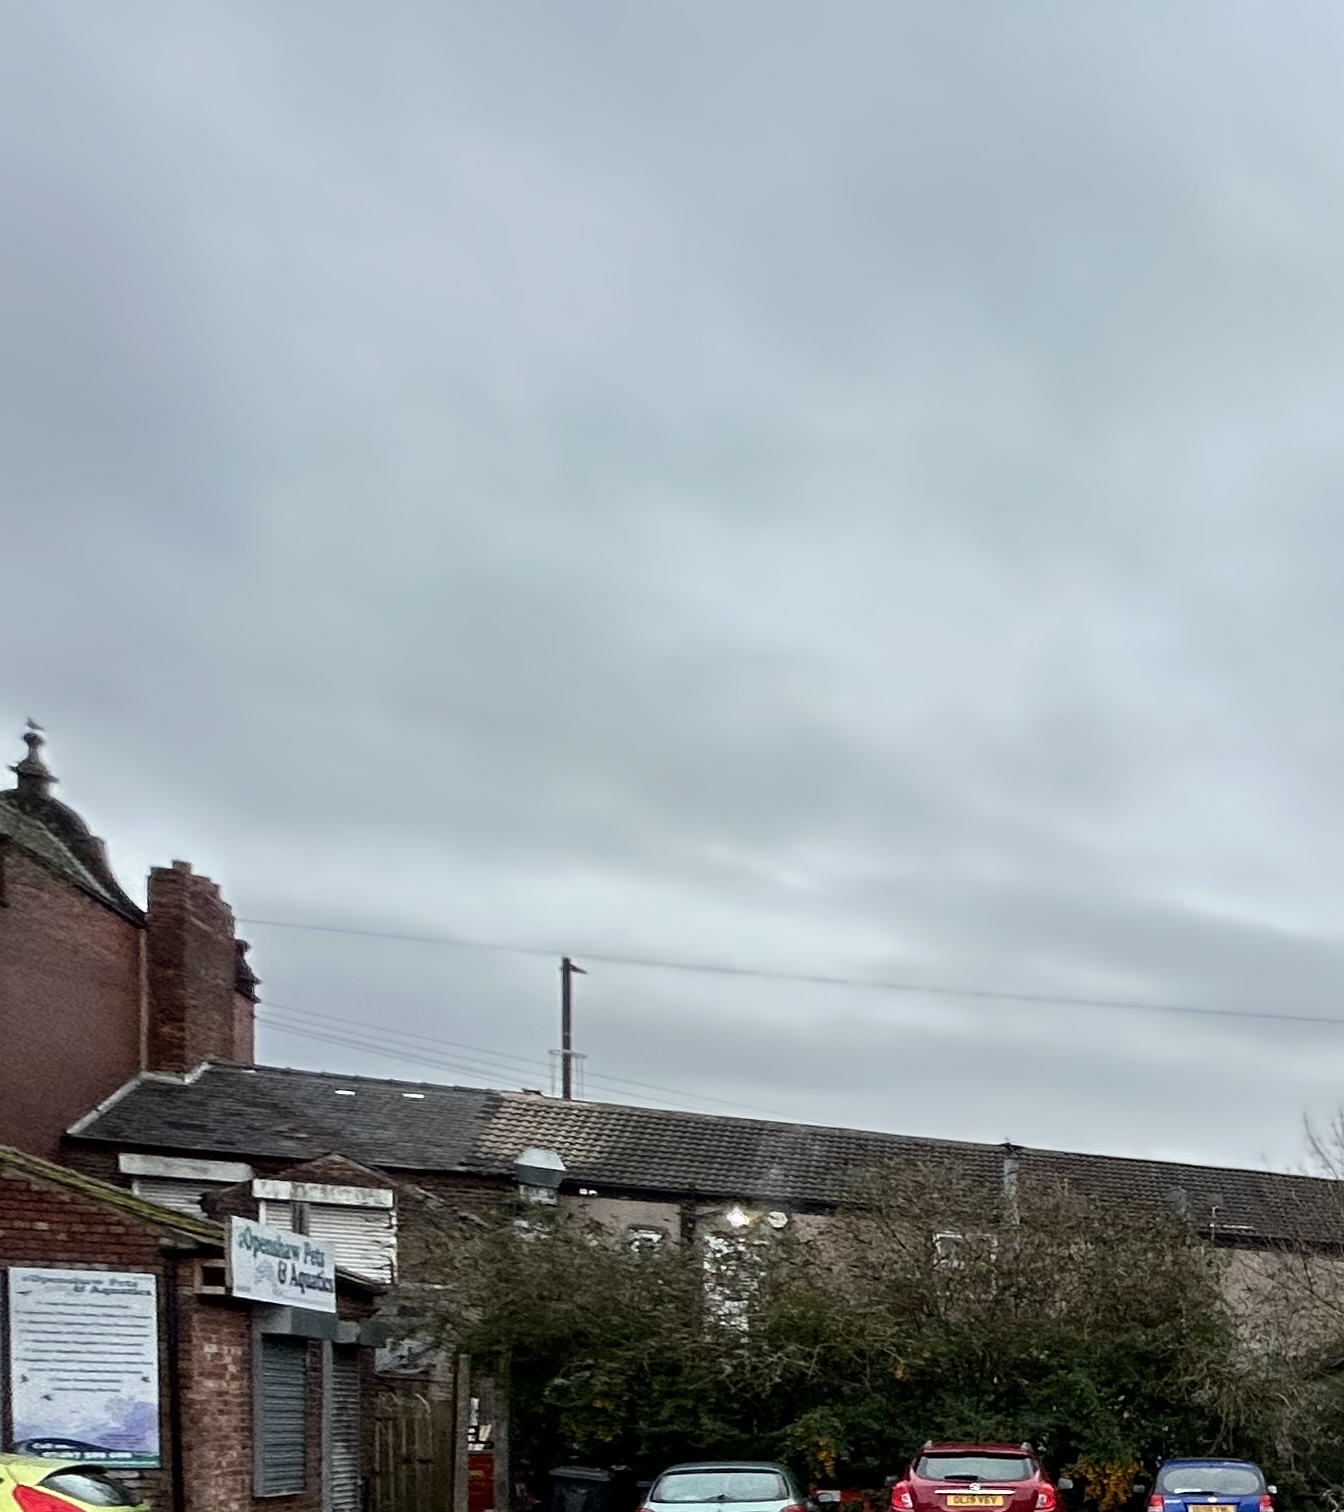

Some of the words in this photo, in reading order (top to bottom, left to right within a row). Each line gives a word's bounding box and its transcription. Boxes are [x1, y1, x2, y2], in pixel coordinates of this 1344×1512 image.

[239, 1225, 301, 1261] Openshaw
[303, 1241, 325, 1268] Pets
[290, 1263, 334, 1294] Aquatics
